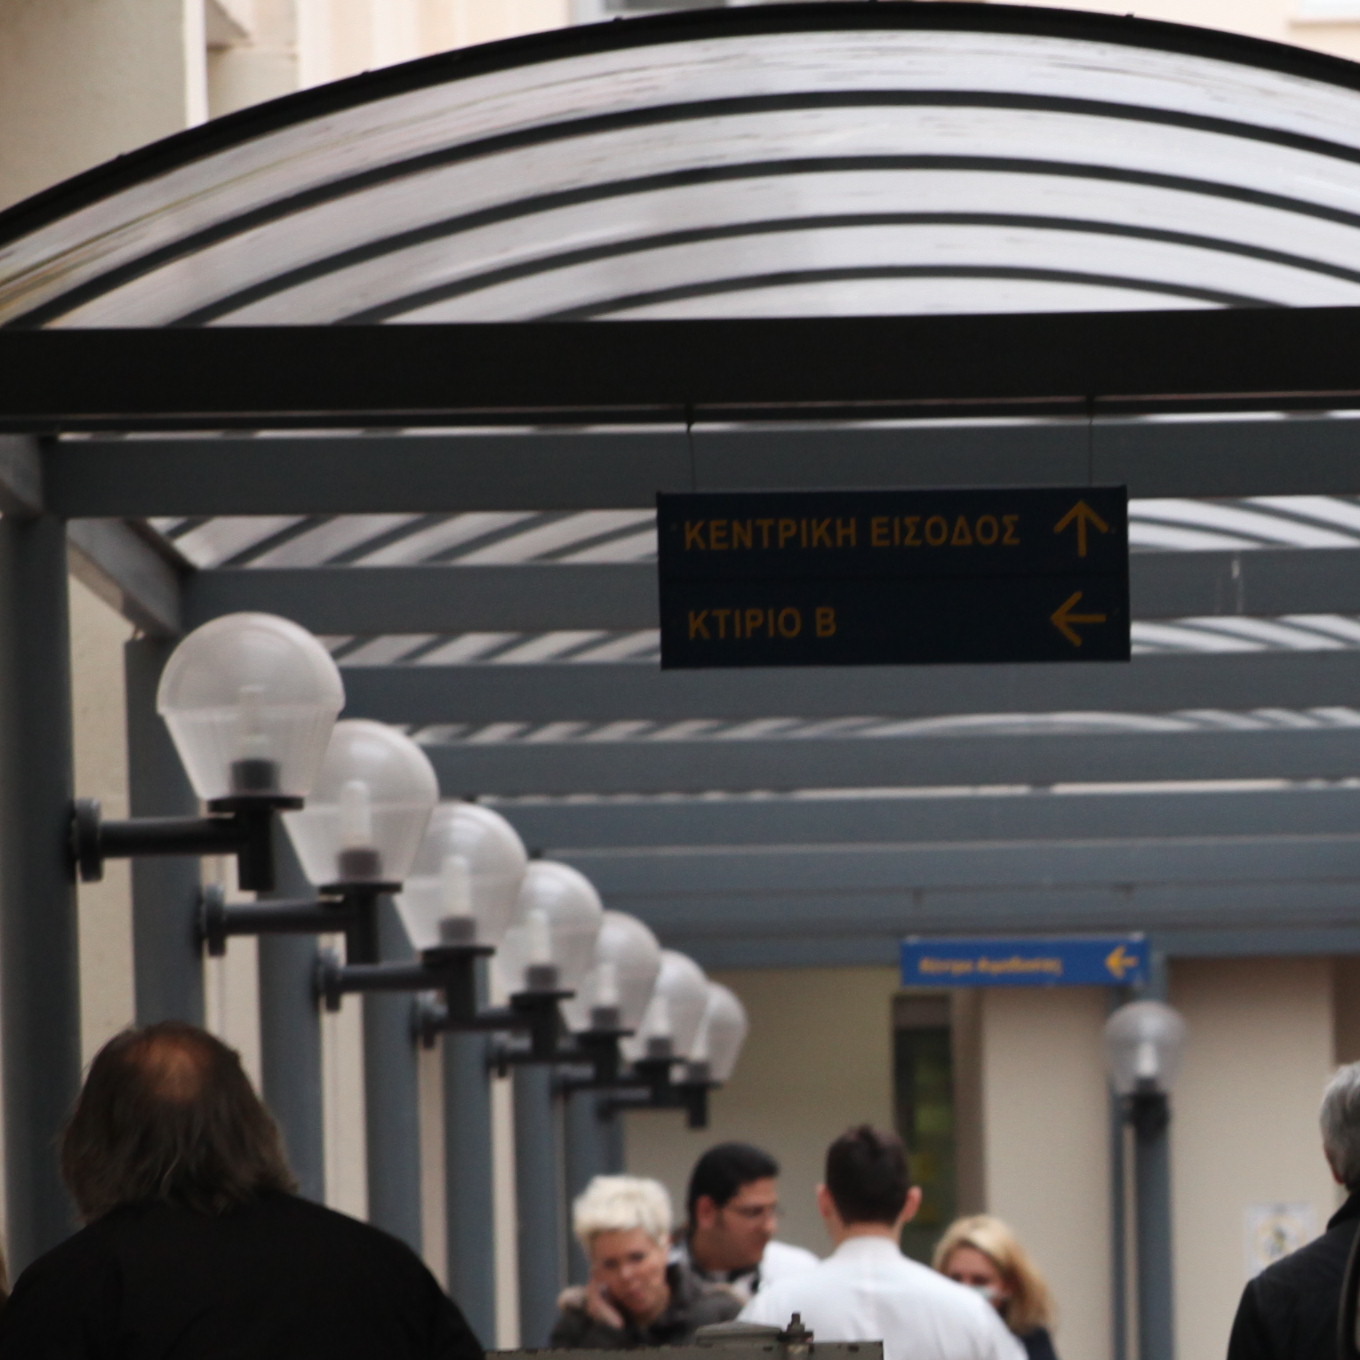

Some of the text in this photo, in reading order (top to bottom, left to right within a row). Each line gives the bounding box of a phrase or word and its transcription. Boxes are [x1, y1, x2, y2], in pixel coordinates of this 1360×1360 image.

[683, 514, 1021, 551] ΚΕΝΤΡΙΚΗ ΕΙΣΟΔΟΣ
[688, 606, 837, 639] ΚΤΙΡΙΟ Β
